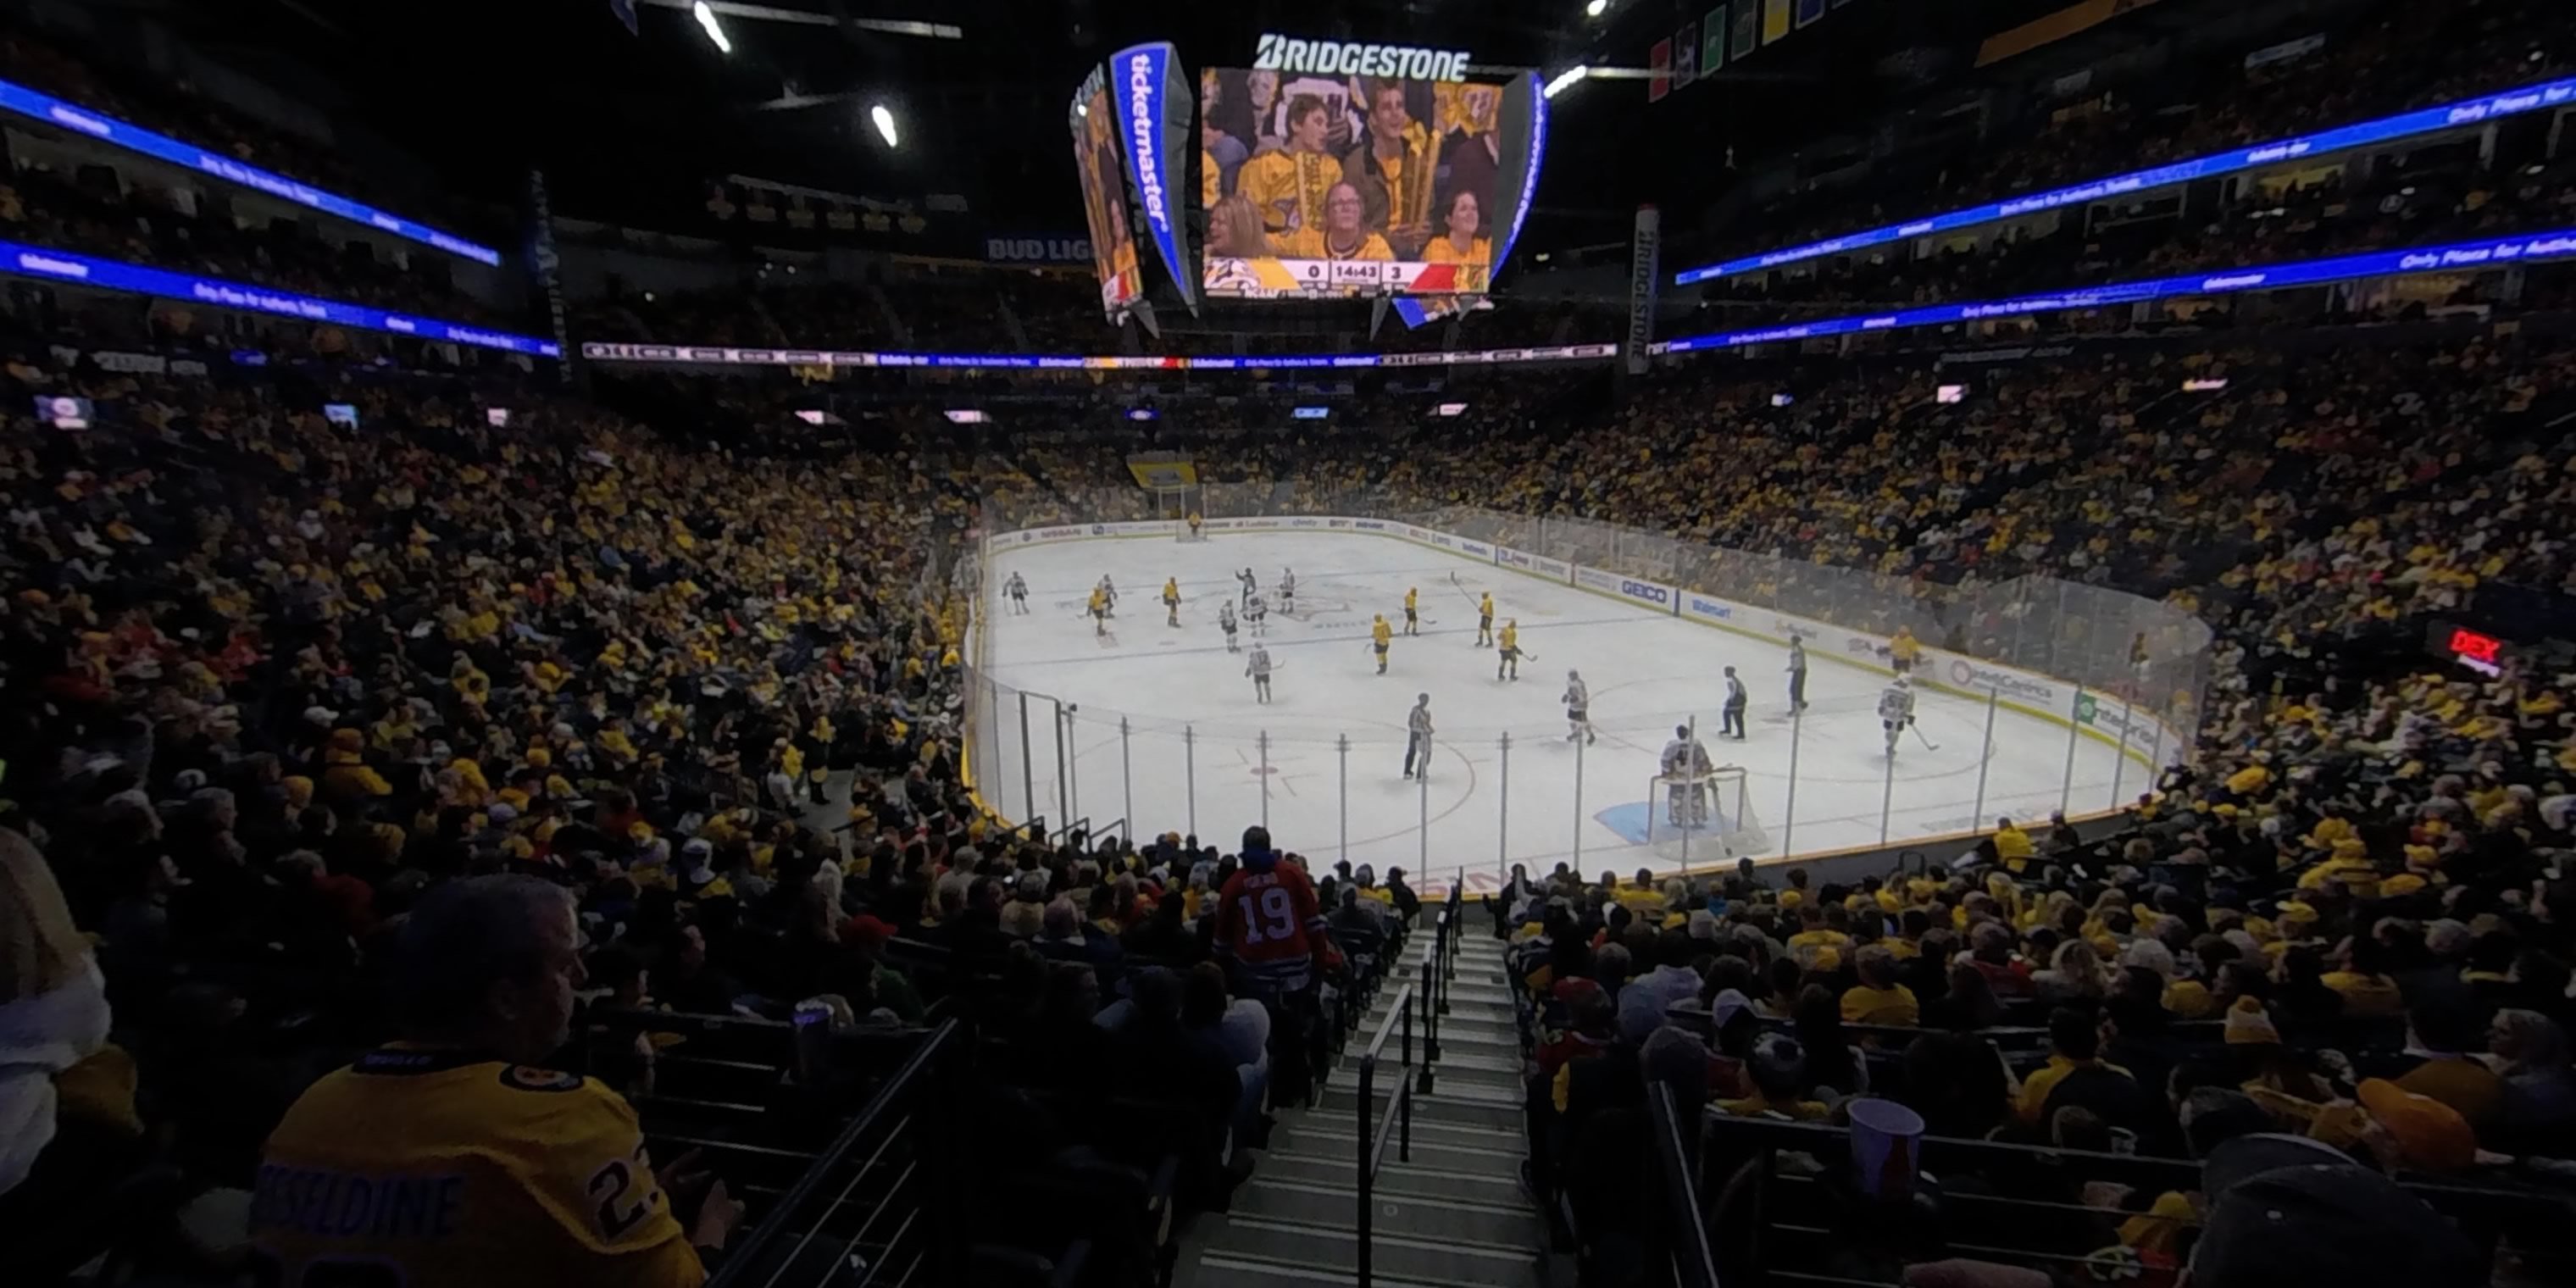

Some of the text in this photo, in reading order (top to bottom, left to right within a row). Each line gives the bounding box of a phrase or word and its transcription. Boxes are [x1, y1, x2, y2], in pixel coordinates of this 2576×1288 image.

[1254, 34, 1470, 82] BRIDGESTONE
[1130, 53, 1166, 225] ticketmaster
[987, 239, 1092, 260] BUD LIG
[1308, 265, 1319, 278] 0
[1336, 266, 1376, 277] 14:43
[1391, 267, 1401, 278] 3
[1622, 580, 1667, 603] GEICO
[1692, 599, 1731, 619] Walmart
[1238, 887, 1296, 945] 19
